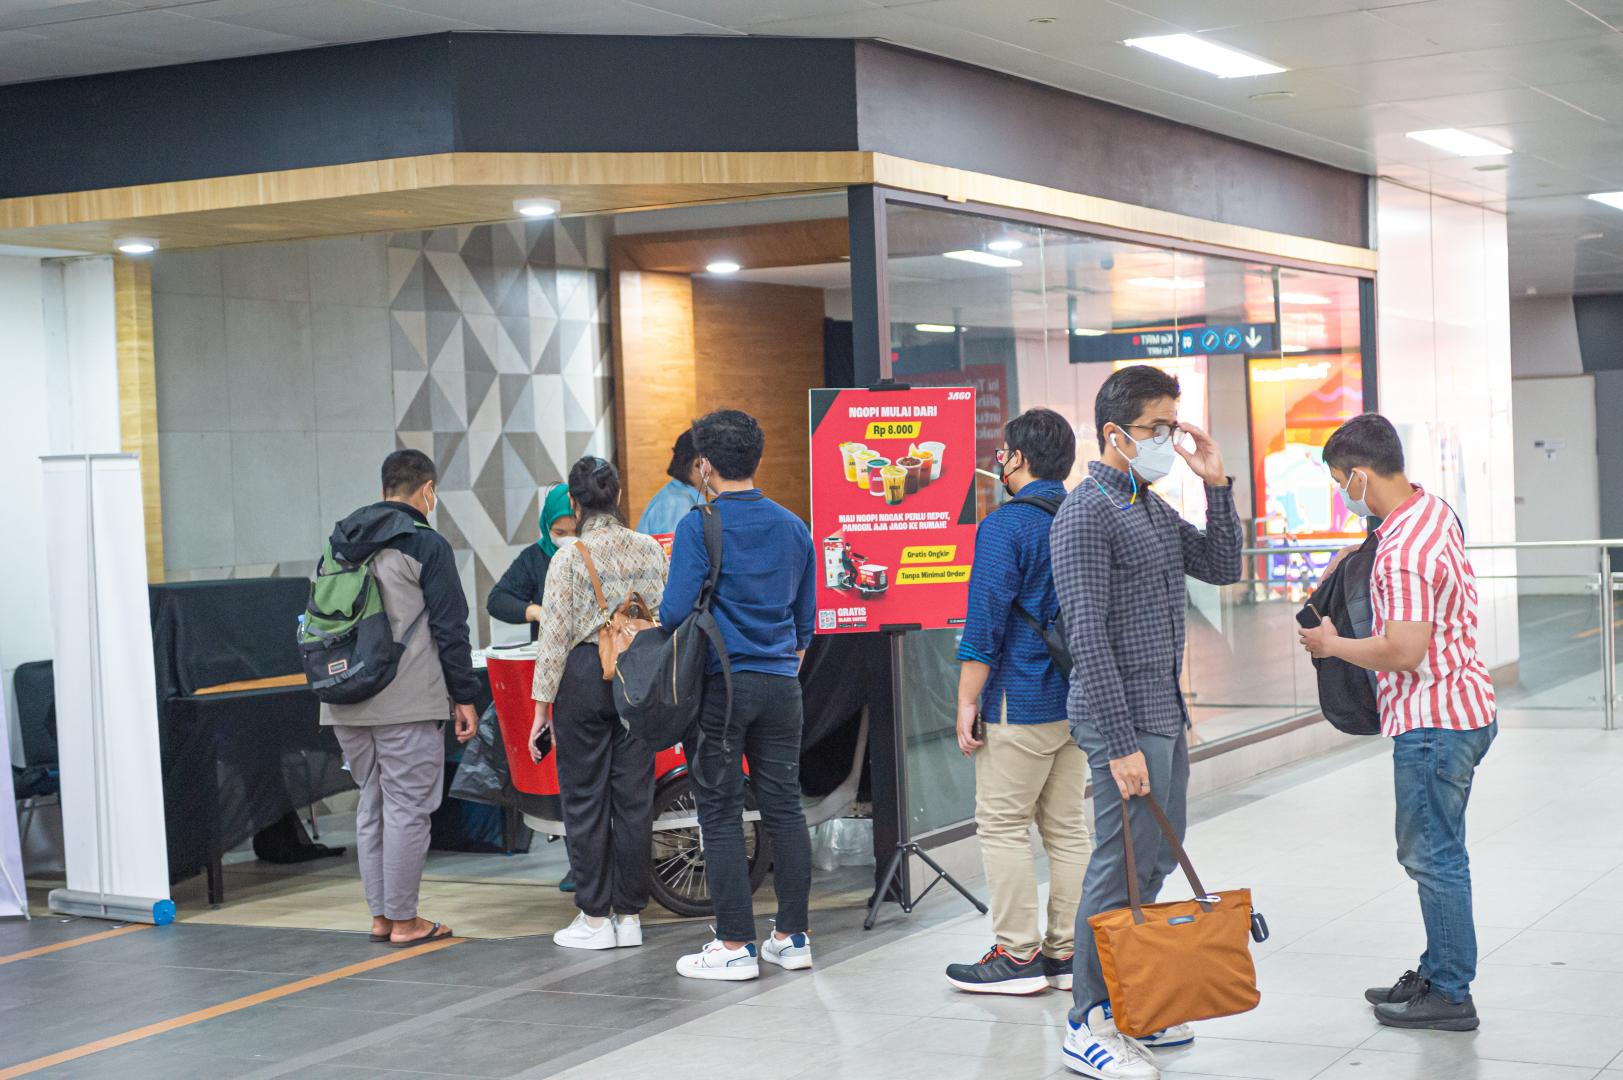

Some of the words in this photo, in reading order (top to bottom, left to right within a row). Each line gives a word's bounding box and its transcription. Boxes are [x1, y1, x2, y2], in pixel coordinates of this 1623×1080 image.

[947, 392, 971, 400] JAGO
[849, 406, 879, 418] NGOPI
[881, 406, 911, 417] MULAI
[914, 405, 937, 417] DARI
[873, 425, 885, 437] Rp
[888, 424, 913, 435] 8.000
[838, 514, 855, 523] MAU
[856, 514, 878, 523] NGOPI
[905, 512, 926, 521] PERLU
[842, 523, 872, 532] PANGGIL
[873, 522, 888, 531] AJA
[889, 522, 908, 530] JAGO
[909, 521, 918, 530] KE
[928, 550, 950, 559] Ongkir
[902, 572, 920, 580] Tanpa
[838, 607, 867, 617] GRATIS
